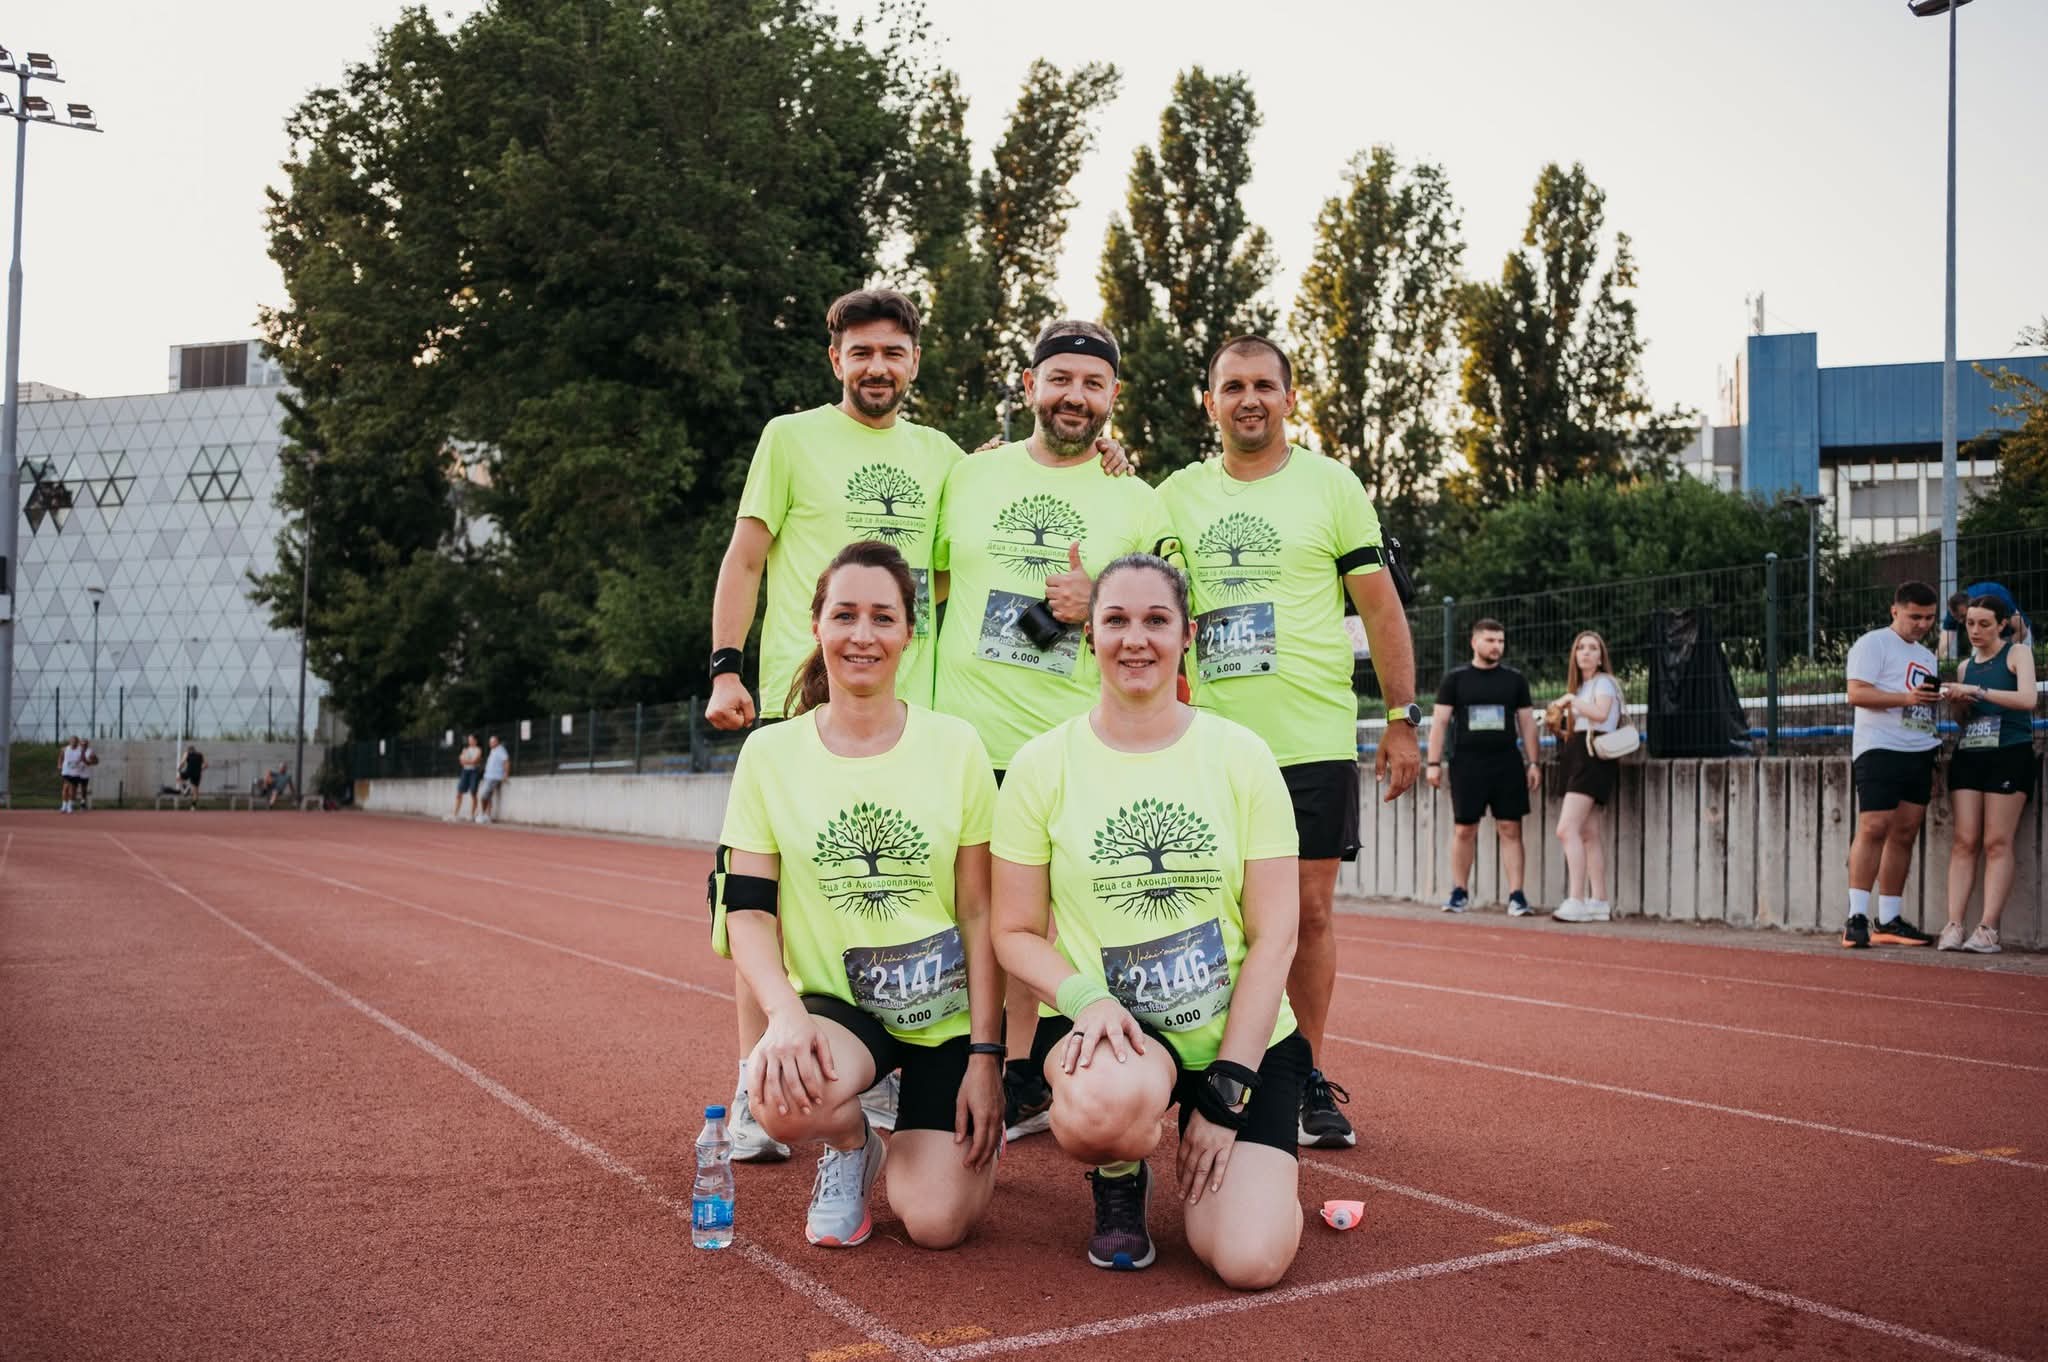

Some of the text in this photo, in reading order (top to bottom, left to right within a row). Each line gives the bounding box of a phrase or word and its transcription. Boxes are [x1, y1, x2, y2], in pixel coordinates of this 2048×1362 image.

[1207, 620, 1256, 656] 2145
[1011, 651, 1040, 665] 6.000
[1217, 662, 1241, 673] 6.000
[1966, 722, 1991, 737] 2295
[842, 880, 852, 889] са
[1093, 873, 1222, 892] Деца са Ахондроплазијом
[870, 953, 942, 1000] 2147
[1129, 949, 1210, 1003] 2146
[896, 1009, 932, 1024] 6.000
[1164, 1008, 1201, 1027] 6.000
